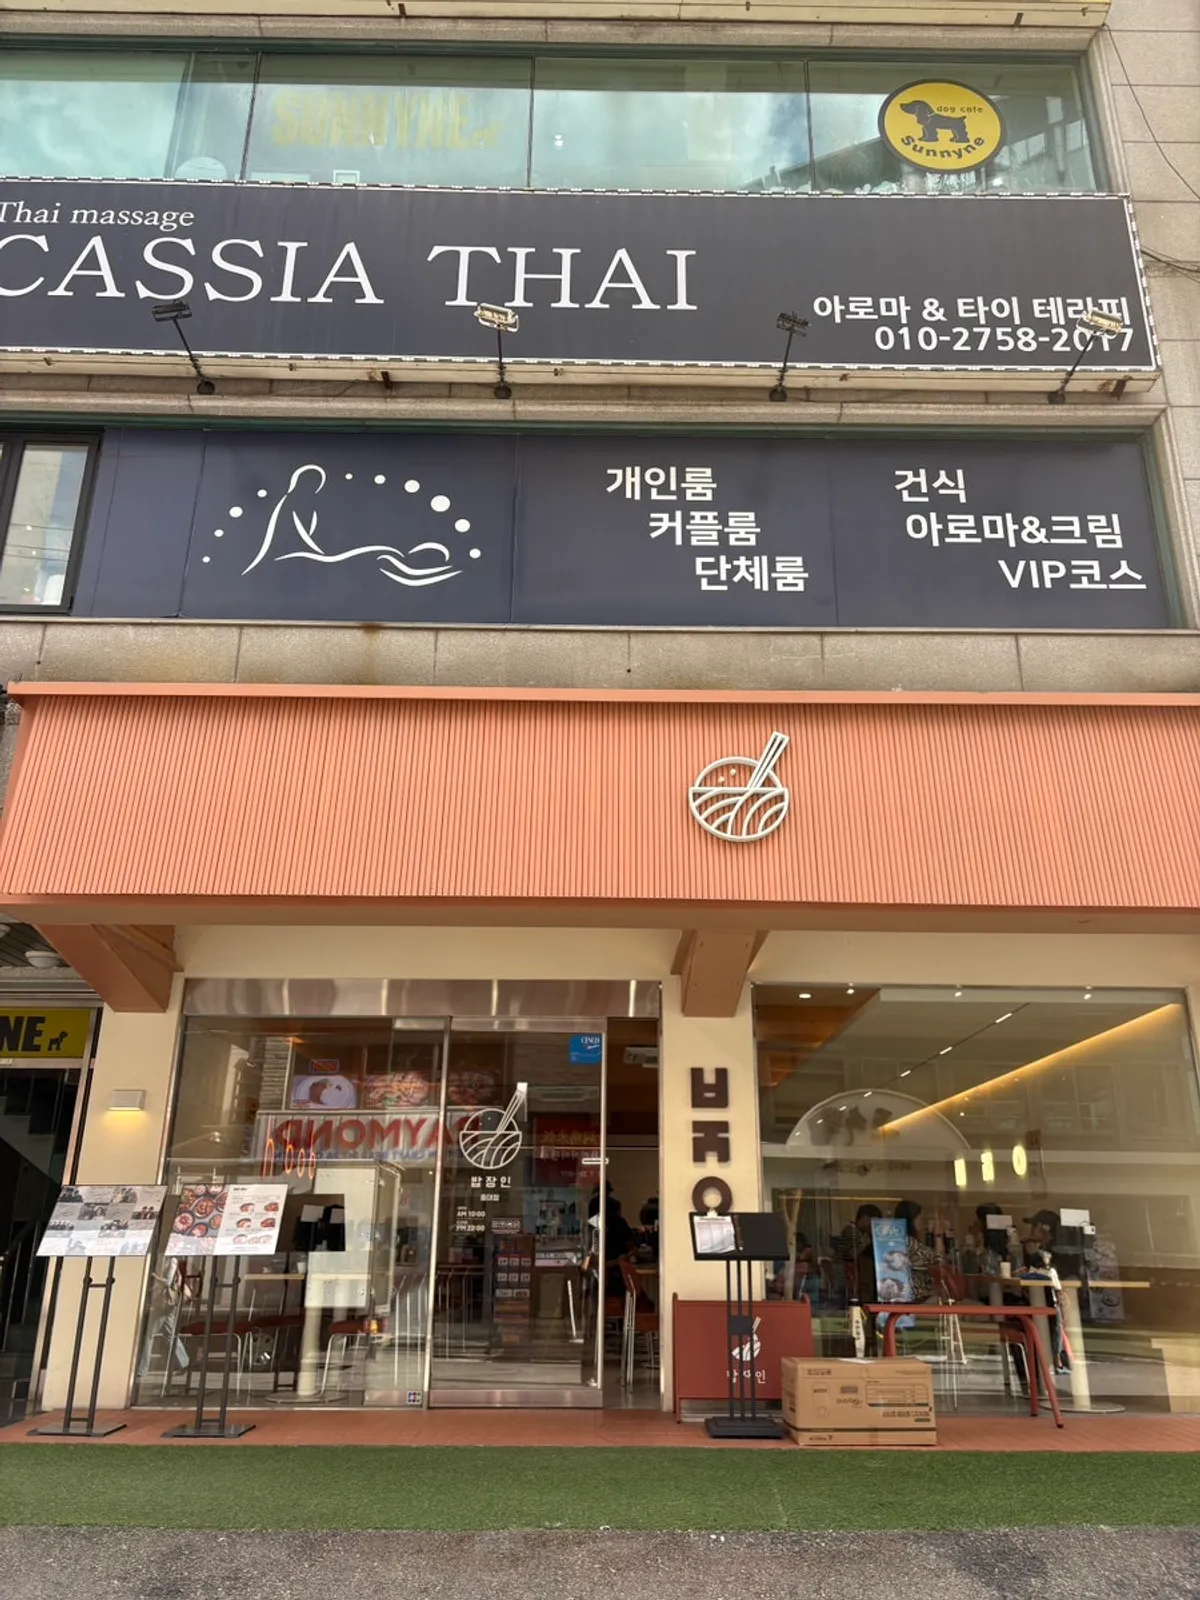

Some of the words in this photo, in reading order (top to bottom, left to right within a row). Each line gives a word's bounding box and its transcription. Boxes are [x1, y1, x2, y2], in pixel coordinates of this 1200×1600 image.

[936, 105, 956, 113] dog
[901, 135, 985, 159] Sunnyne
[0, 201, 61, 224] Thai
[70, 206, 195, 232] massage
[0, 234, 385, 304] CASSIA
[426, 245, 698, 309] THAI
[813, 295, 911, 324] 아로마
[922, 297, 948, 322] &
[956, 296, 1021, 325] 타이
[606, 466, 717, 501] 개인룸
[894, 468, 967, 503] 건식
[649, 510, 761, 546] 커플룸
[906, 511, 1123, 549] 아로마&크림
[695, 554, 809, 592] 단체룸
[997, 558, 1147, 590] VIP코스
